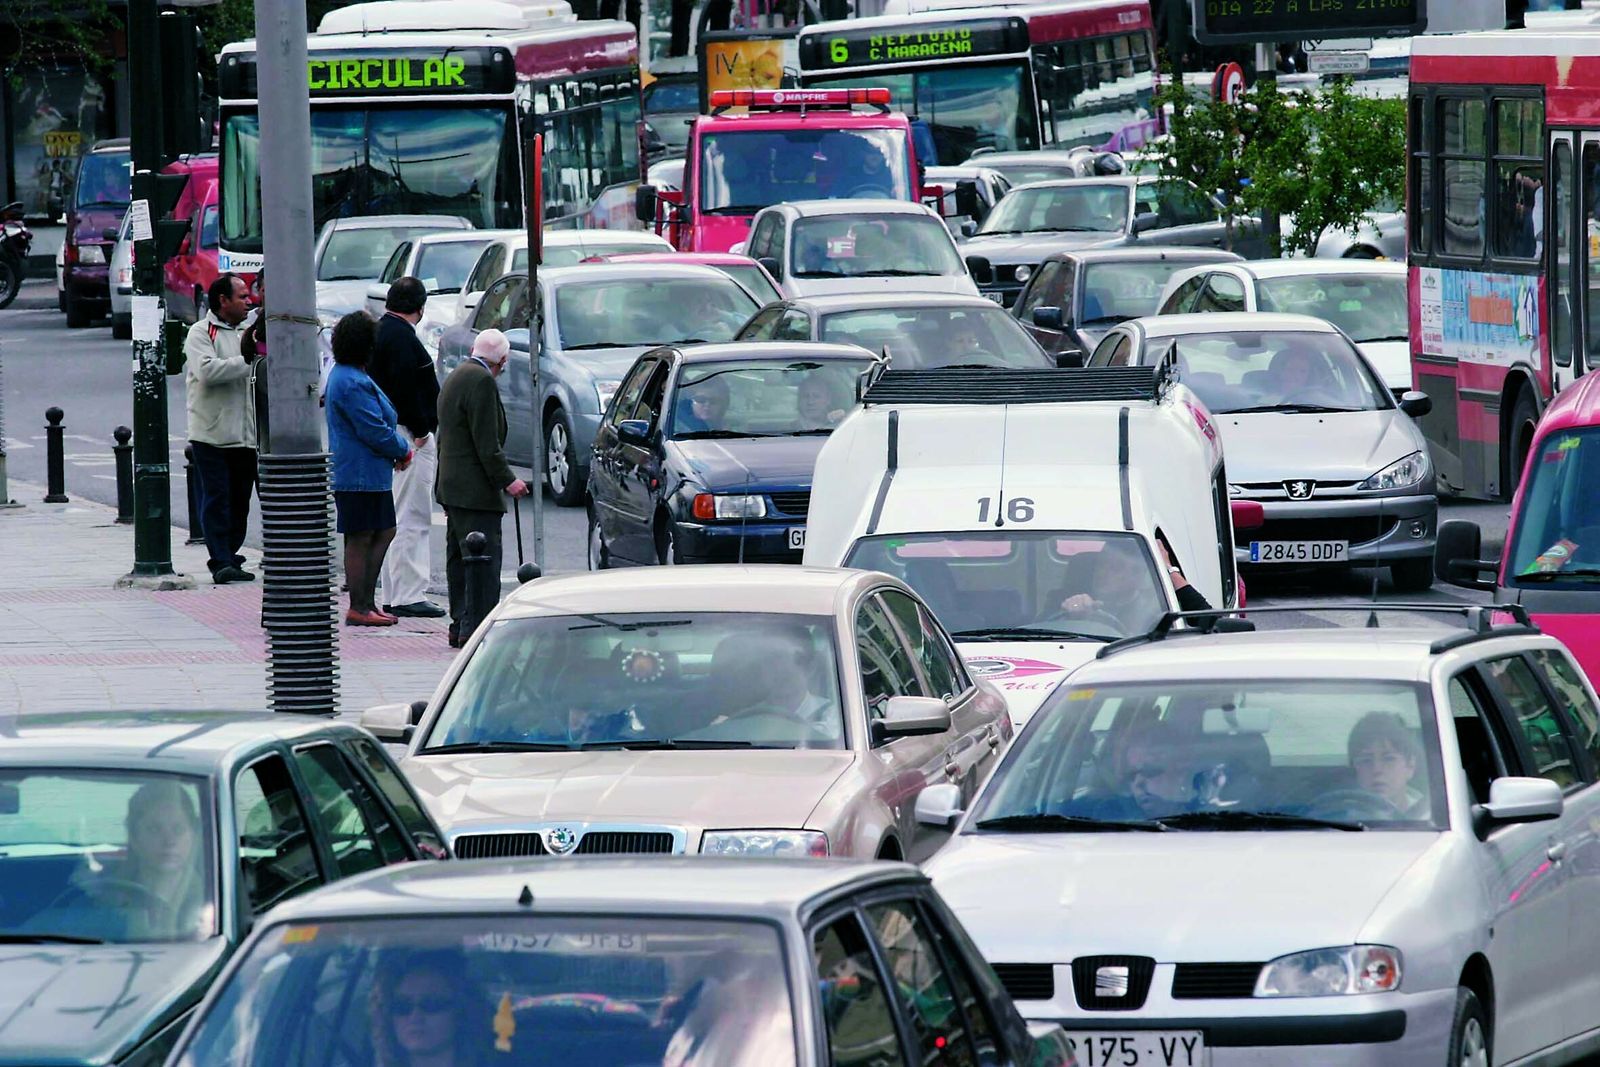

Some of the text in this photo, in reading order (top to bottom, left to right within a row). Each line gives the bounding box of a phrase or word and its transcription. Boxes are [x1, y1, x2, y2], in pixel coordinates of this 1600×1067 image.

[1287, 1, 1298, 12] A
[869, 27, 971, 47] NEPTUNO
[830, 38, 849, 63] 6
[887, 39, 972, 59] MARACENA
[307, 55, 465, 89] CIRCULAR
[785, 93, 828, 101] MAPFRE
[976, 497, 1035, 523] 16
[1262, 544, 1307, 560] 2845
[1312, 543, 1344, 560] DDP
